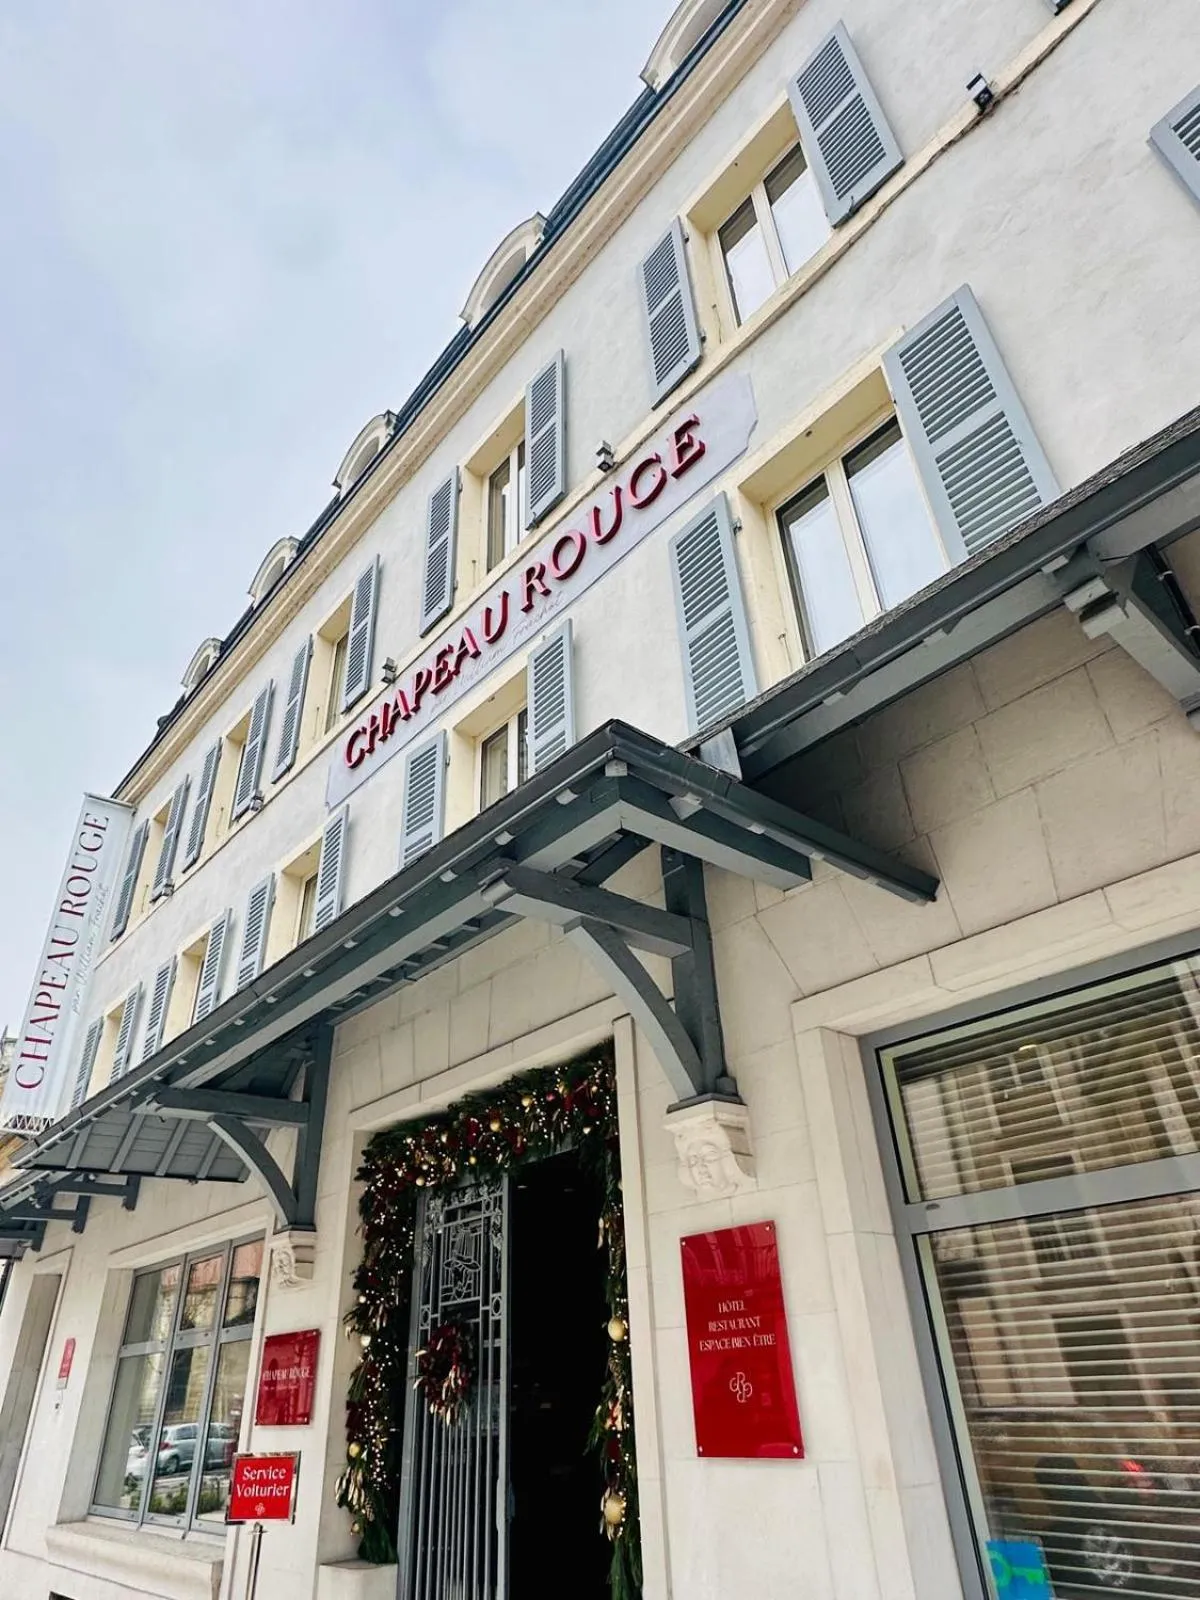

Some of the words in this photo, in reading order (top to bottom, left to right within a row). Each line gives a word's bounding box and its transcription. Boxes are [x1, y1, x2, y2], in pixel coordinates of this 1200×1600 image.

[344, 591, 510, 770] CHAPEAU
[520, 413, 707, 612] ROUGE
[15, 925, 79, 1089] CHAPEAU
[59, 811, 109, 918] ROUGE
[708, 1315, 761, 1332] RESTAURANT
[242, 1465, 287, 1480] Service
[236, 1483, 290, 1498] Voiturier
